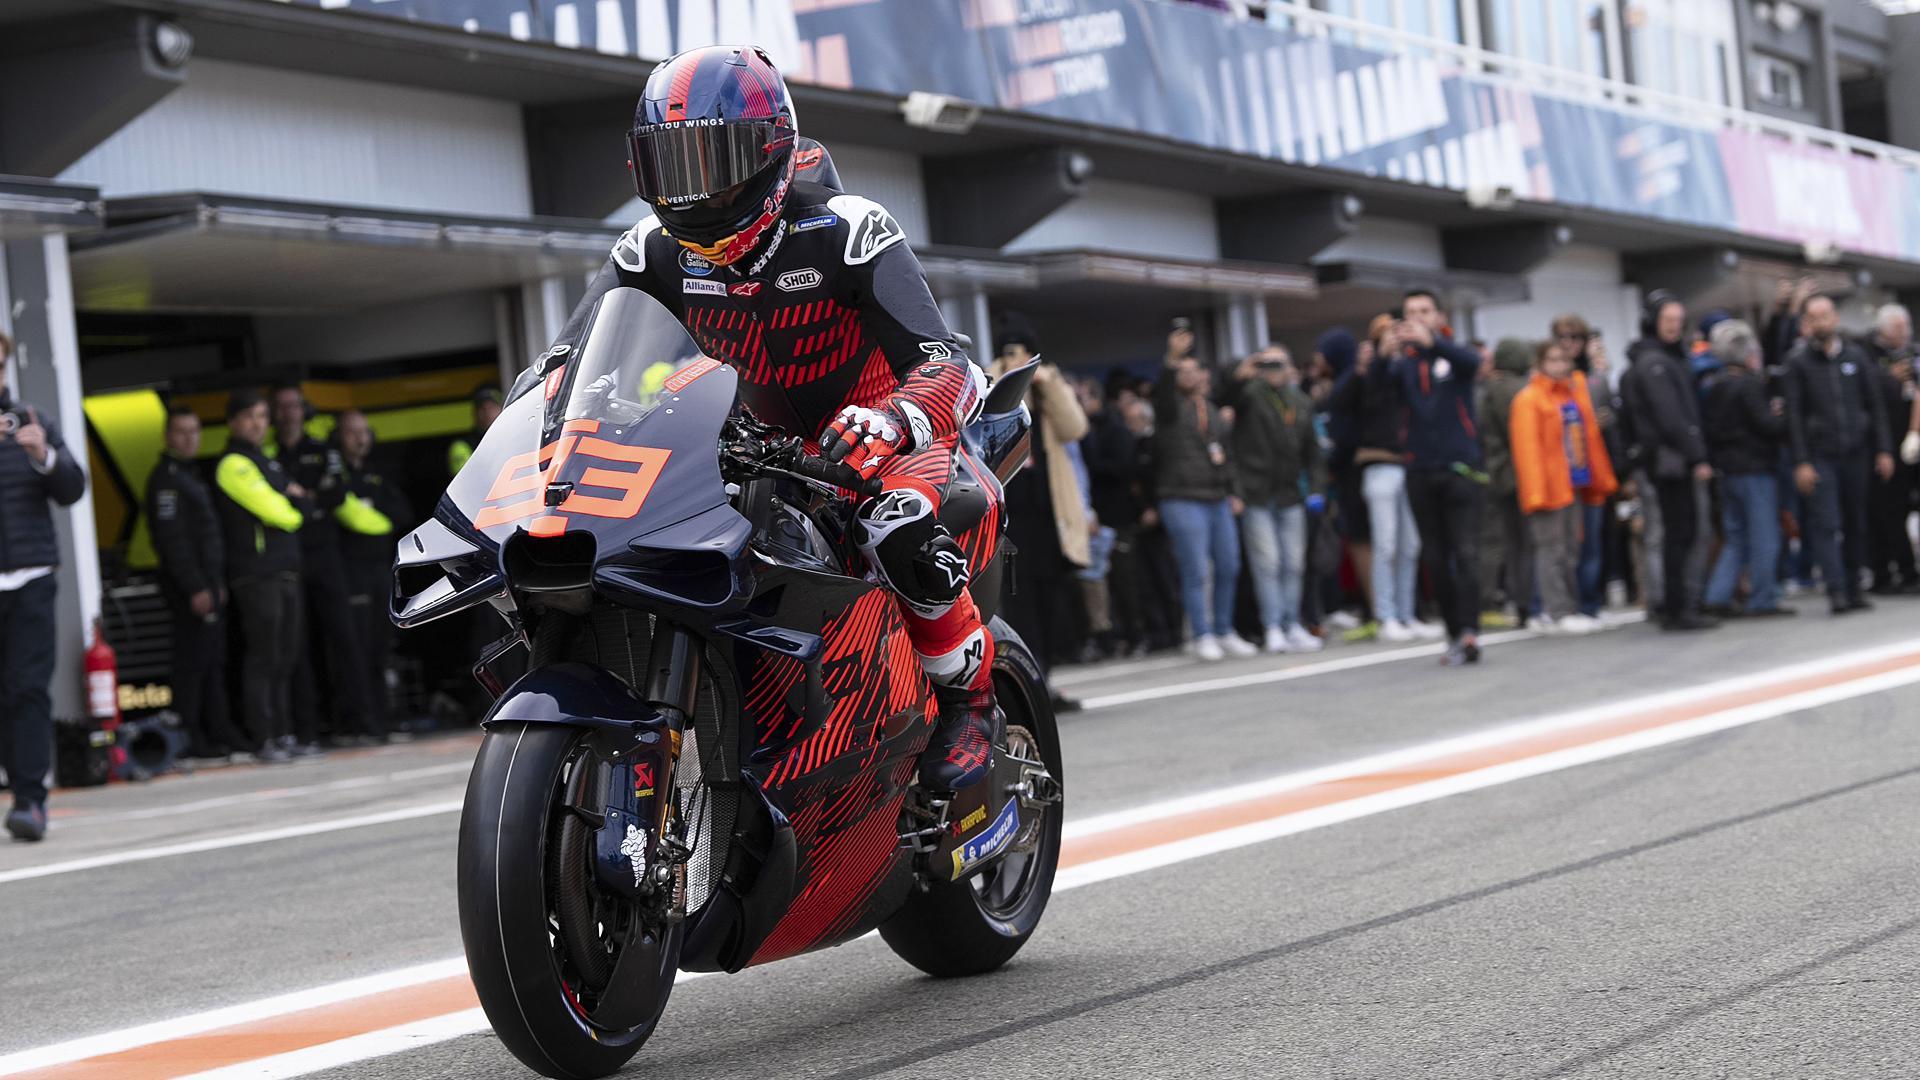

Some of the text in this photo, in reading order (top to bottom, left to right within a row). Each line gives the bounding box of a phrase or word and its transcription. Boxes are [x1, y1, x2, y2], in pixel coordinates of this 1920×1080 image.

[659, 121, 680, 130] YOU
[685, 118, 725, 128] WINGS
[667, 192, 711, 204] VERTICAL
[800, 218, 833, 229] MICHELIN
[749, 218, 787, 276] alpinestars
[686, 258, 709, 269] Galicia
[684, 281, 716, 292] Allianz
[783, 274, 816, 288] SHOEI
[473, 434, 673, 531] 93
